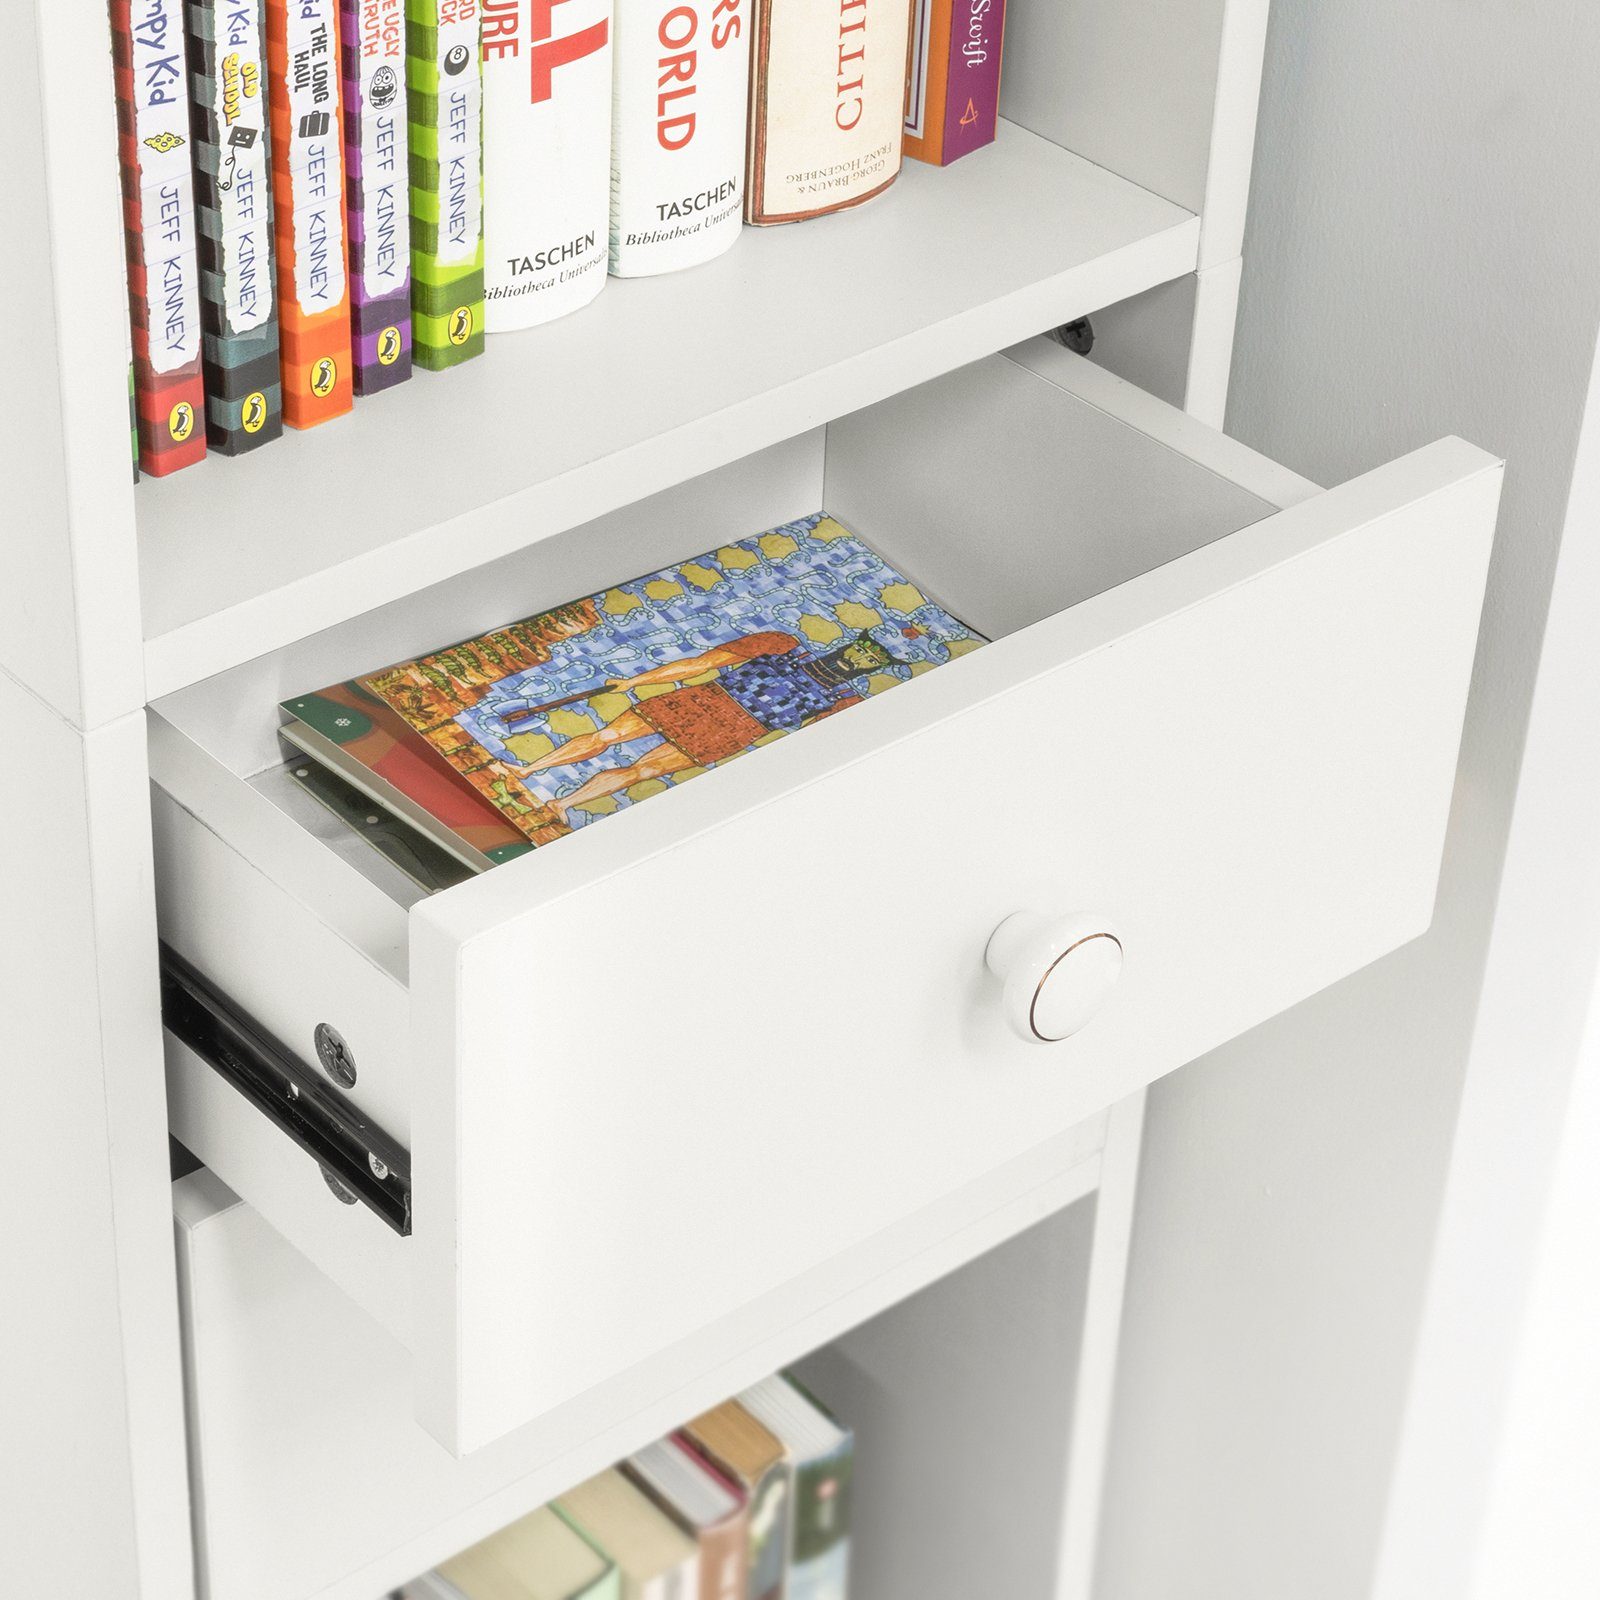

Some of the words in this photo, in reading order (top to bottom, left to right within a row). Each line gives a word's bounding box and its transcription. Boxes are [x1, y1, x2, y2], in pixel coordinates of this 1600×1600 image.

[227, 8, 250, 46] Kid
[299, 0, 321, 19] id
[364, 0, 380, 57] RUTH
[440, 0, 457, 26] CK
[310, 22, 328, 57] THE
[382, 12, 399, 57] UGLY
[453, 47, 463, 60] 8
[962, 0, 991, 68] Swift
[145, 54, 180, 106] Kid
[222, 52, 241, 126] SCHOOL
[241, 62, 258, 98] OLD
[294, 50, 310, 93] HAUL
[312, 61, 329, 104] LONG
[657, 6, 698, 151] ORLD
[450, 91, 466, 143] JEFF
[376, 116, 394, 171] JEFF
[863, 142, 892, 164] FRANZ
[308, 144, 326, 197] JEFF
[786, 158, 860, 183] HOGENBERG
[797, 186, 806, 194] &
[808, 175, 849, 193] BRAUN
[852, 159, 885, 181] GEORG
[160, 186, 181, 242] JEFF
[236, 168, 254, 219] JEFF
[450, 155, 466, 244] KINNEY
[656, 176, 736, 221] TASCHEN
[377, 184, 396, 279] KINNEY
[507, 230, 595, 276] TASCHEN
[625, 222, 701, 246] Bibliotheca
[238, 231, 257, 318] KINNEY
[309, 209, 328, 300] KINNEY
[163, 255, 185, 351] KINNEY
